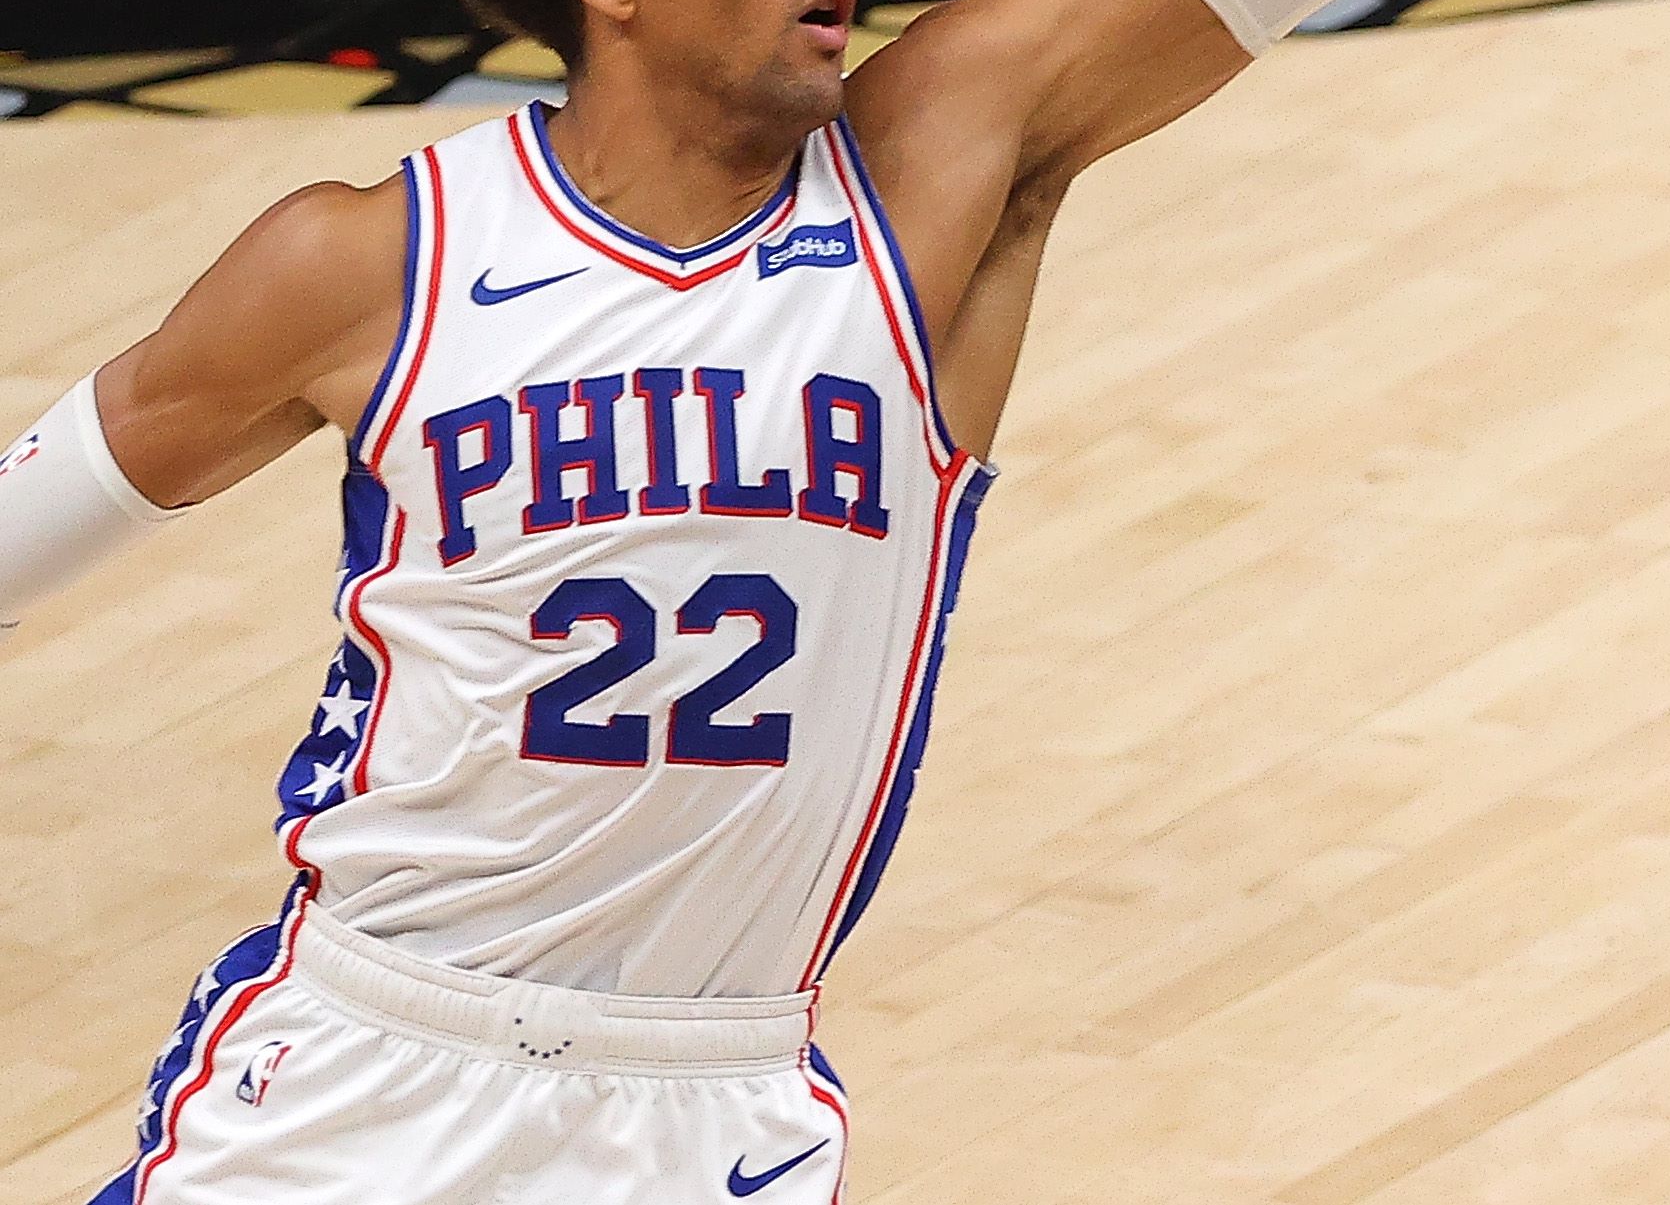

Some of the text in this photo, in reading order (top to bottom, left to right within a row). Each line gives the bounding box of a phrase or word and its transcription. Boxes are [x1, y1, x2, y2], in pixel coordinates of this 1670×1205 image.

[766, 236, 848, 270] SbHub
[423, 366, 890, 568] PHILA
[519, 572, 799, 768] 22
